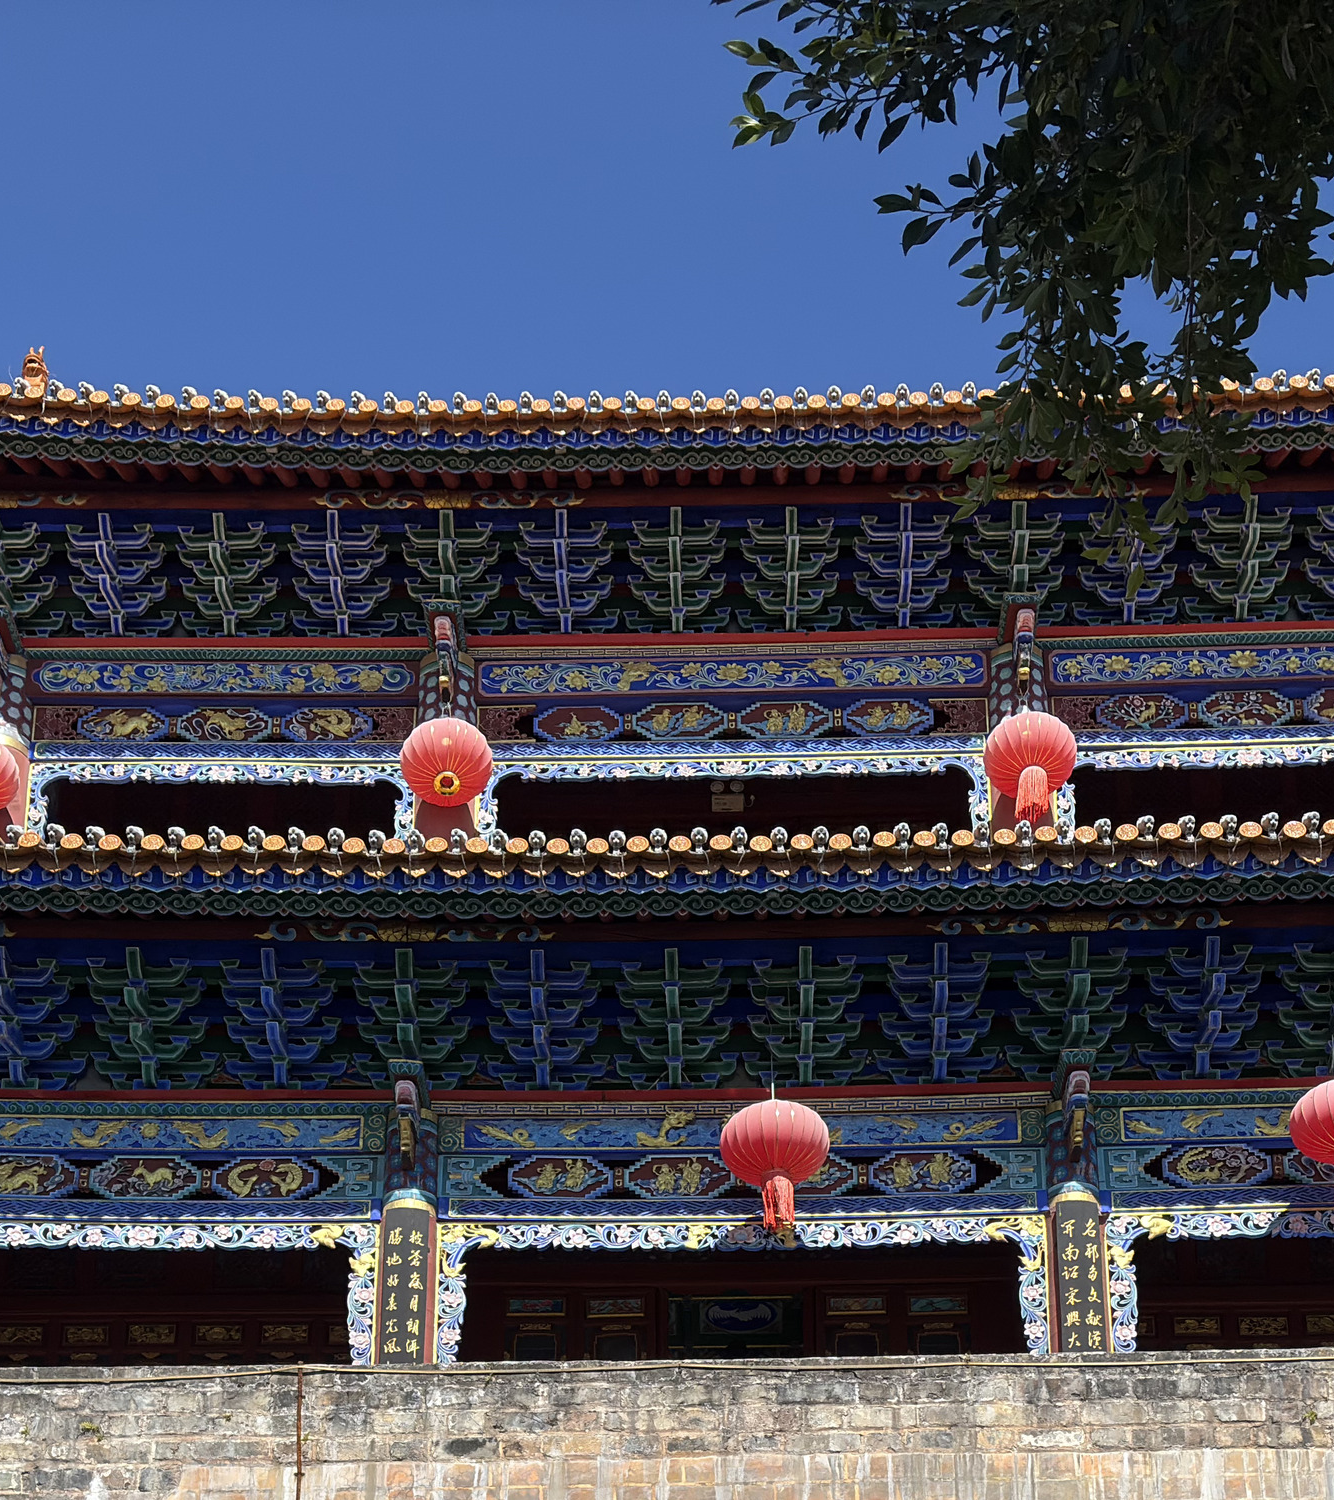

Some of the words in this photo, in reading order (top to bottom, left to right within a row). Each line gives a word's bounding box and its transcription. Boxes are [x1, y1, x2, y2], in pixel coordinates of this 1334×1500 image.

[383, 1226, 404, 1366] 勝地好春光風
